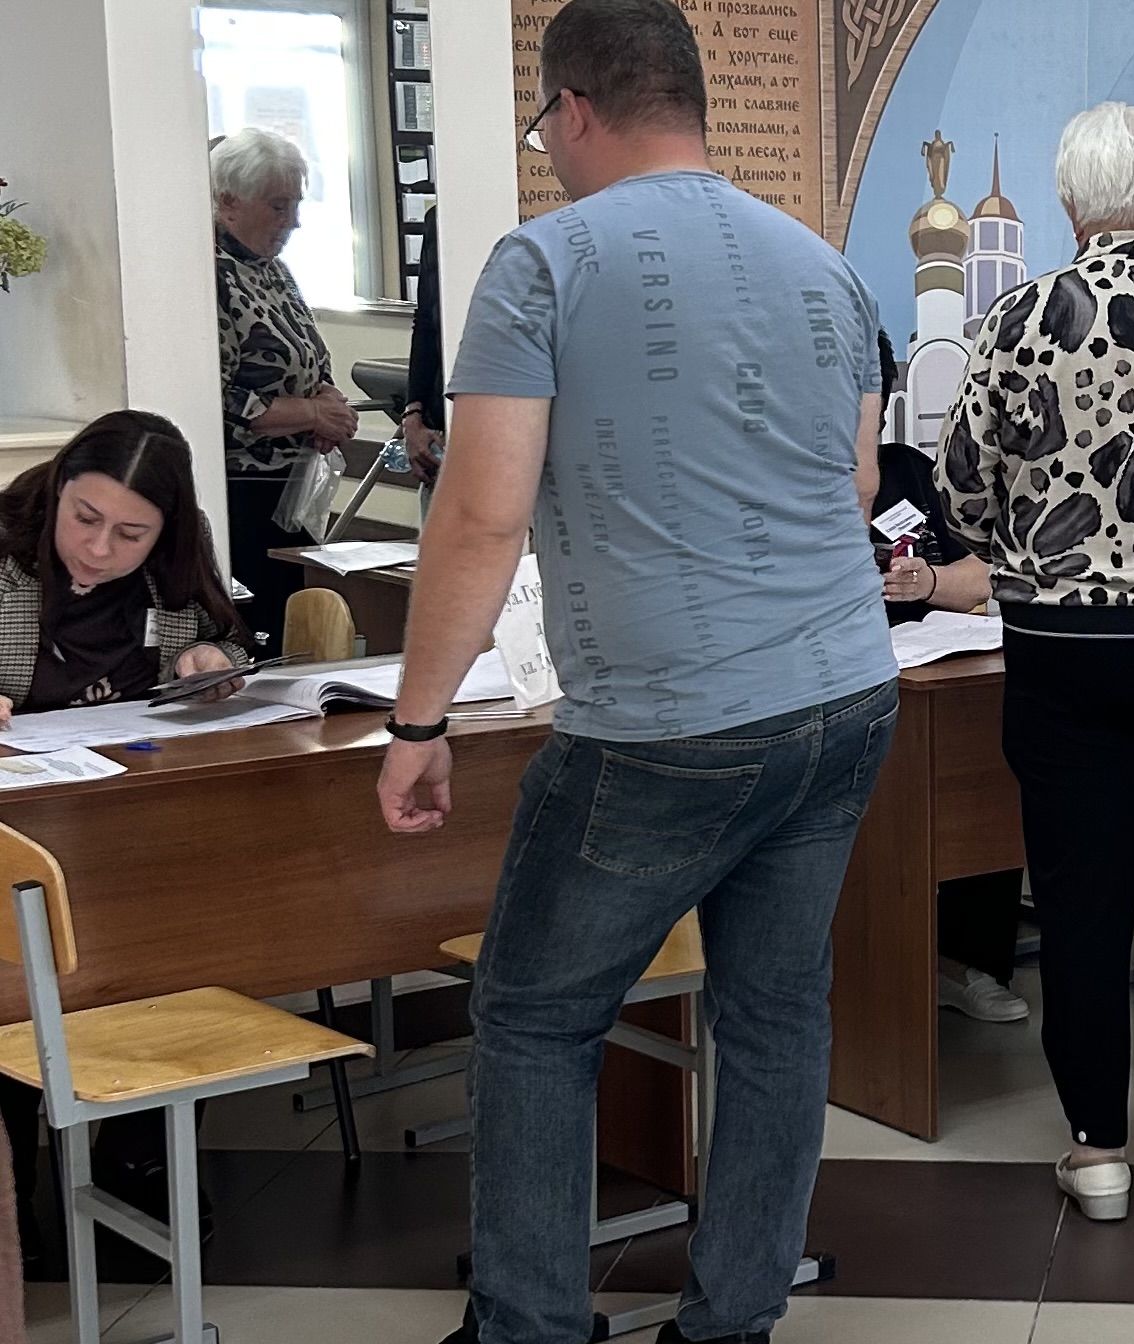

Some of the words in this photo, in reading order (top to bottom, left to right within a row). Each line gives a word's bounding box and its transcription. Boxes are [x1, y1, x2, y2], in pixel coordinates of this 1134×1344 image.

[703, 0, 712, 13] и
[717, 1, 797, 18] прозвались
[513, 15, 553, 32] друг
[712, 20, 724, 38] А
[733, 26, 760, 39] вот
[768, 28, 799, 44] еще
[707, 49, 717, 61] и
[728, 49, 799, 68] хорутане.
[709, 73, 766, 91] ляхами,
[770, 76, 778, 88] а
[782, 76, 800, 88] от
[709, 97, 737, 110] эти
[744, 98, 801, 112] славяне
[716, 121, 789, 137] полянами,
[792, 124, 801, 136] а
[735, 145, 744, 158] в
[747, 146, 790, 163] лесах,
[793, 147, 801, 159] а
[731, 164, 787, 184] Двиною
[793, 170, 802, 182] и
[519, 190, 572, 206] дрегов
[793, 194, 802, 205] и
[631, 229, 679, 383] VERSINO
[800, 289, 840, 369] KINGS
[736, 362, 769, 434] CLUB
[575, 463, 609, 554] NINE/ZERO
[737, 500, 775, 577] ROYAL
